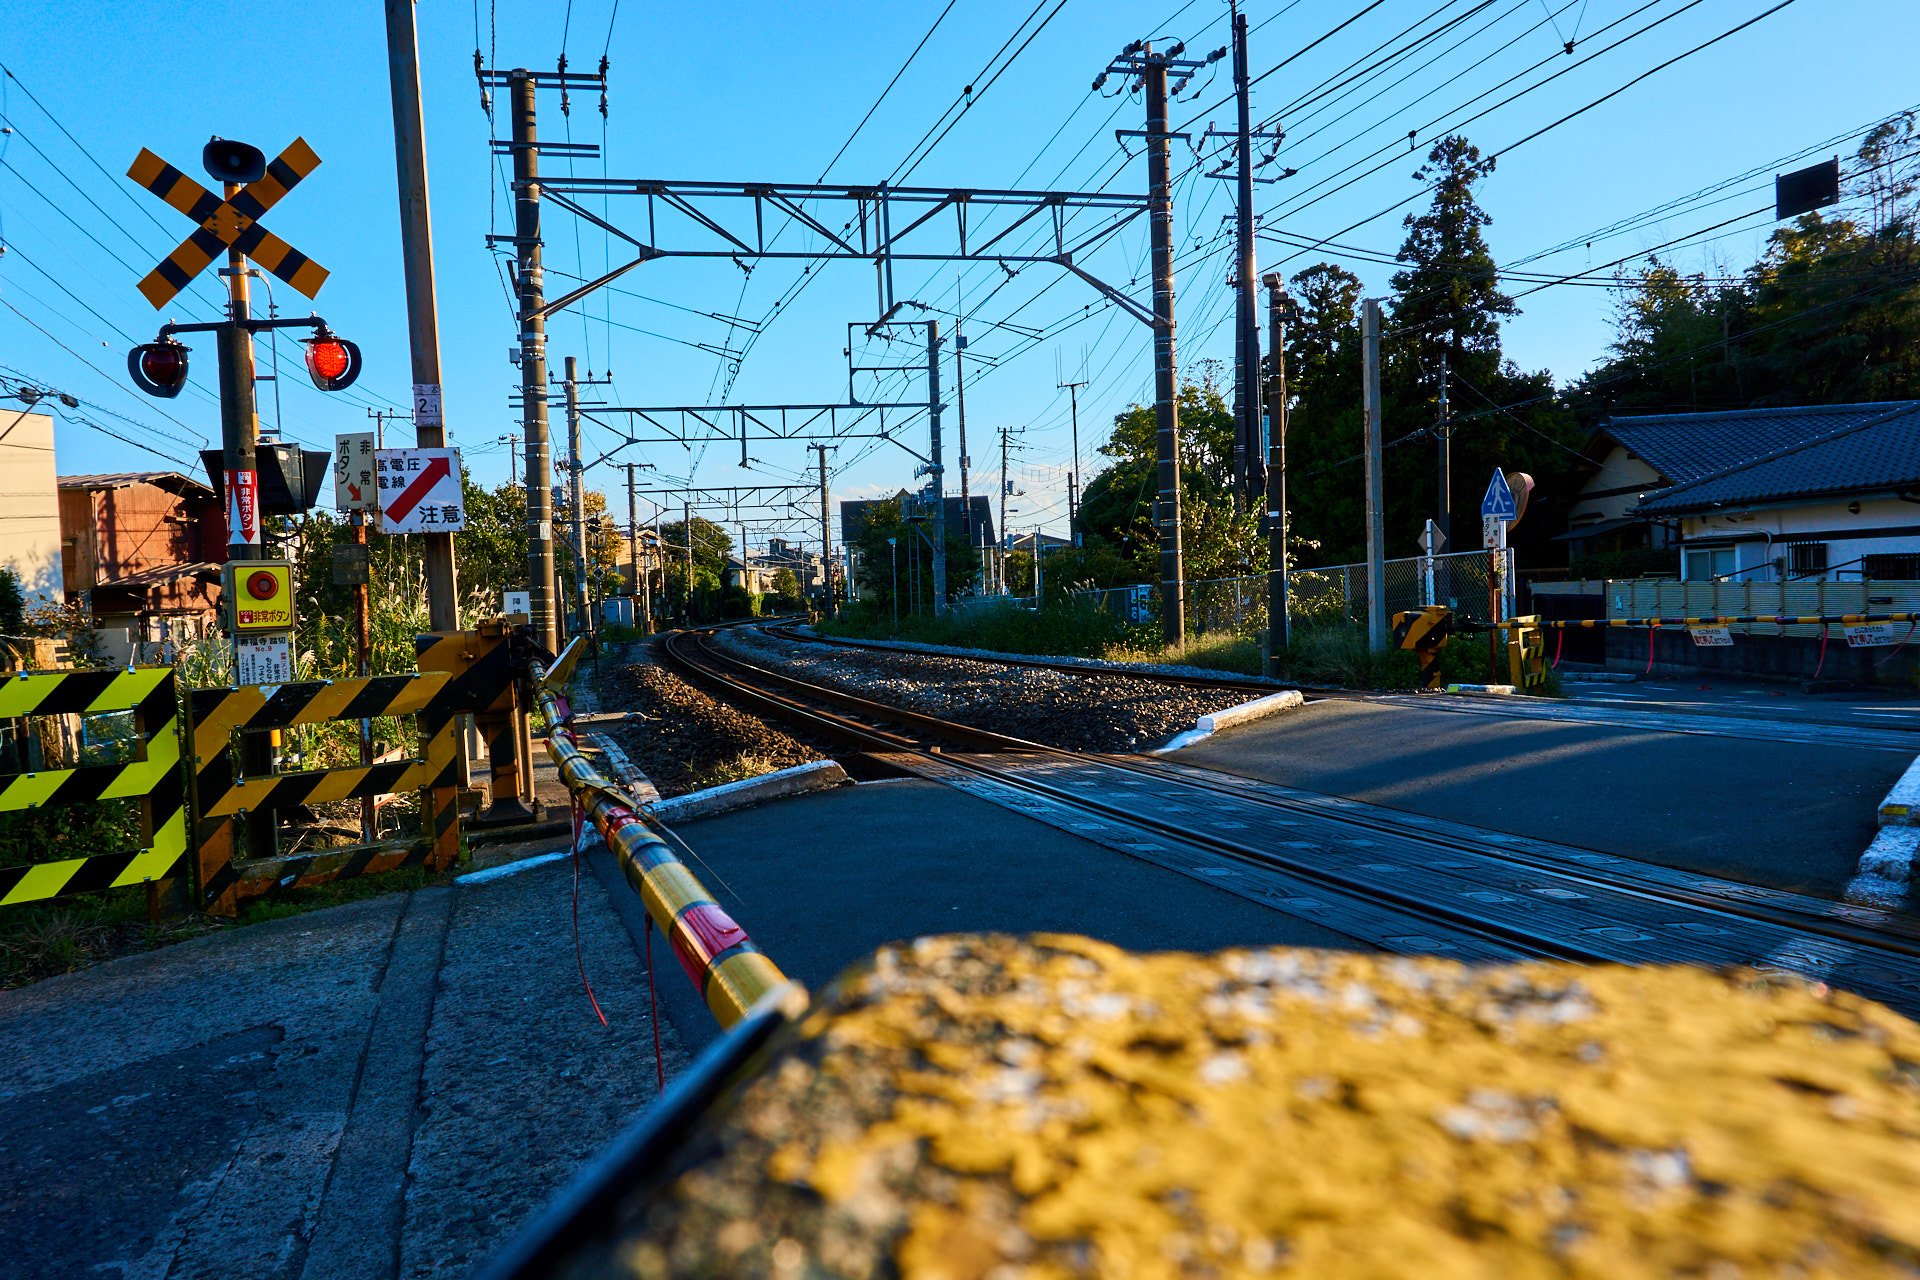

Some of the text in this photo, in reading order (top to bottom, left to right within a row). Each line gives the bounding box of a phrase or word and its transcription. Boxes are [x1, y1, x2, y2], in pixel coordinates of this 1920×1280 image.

[339, 439, 351, 485] ボタン
[360, 439, 371, 486] 非常
[377, 458, 420, 471] 高電圧
[378, 475, 406, 489] 電線
[240, 487, 253, 530] 非常ボタン
[419, 504, 461, 524] 注意
[253, 610, 289, 624] 非常ボタン
[255, 645, 272, 653] No.9
